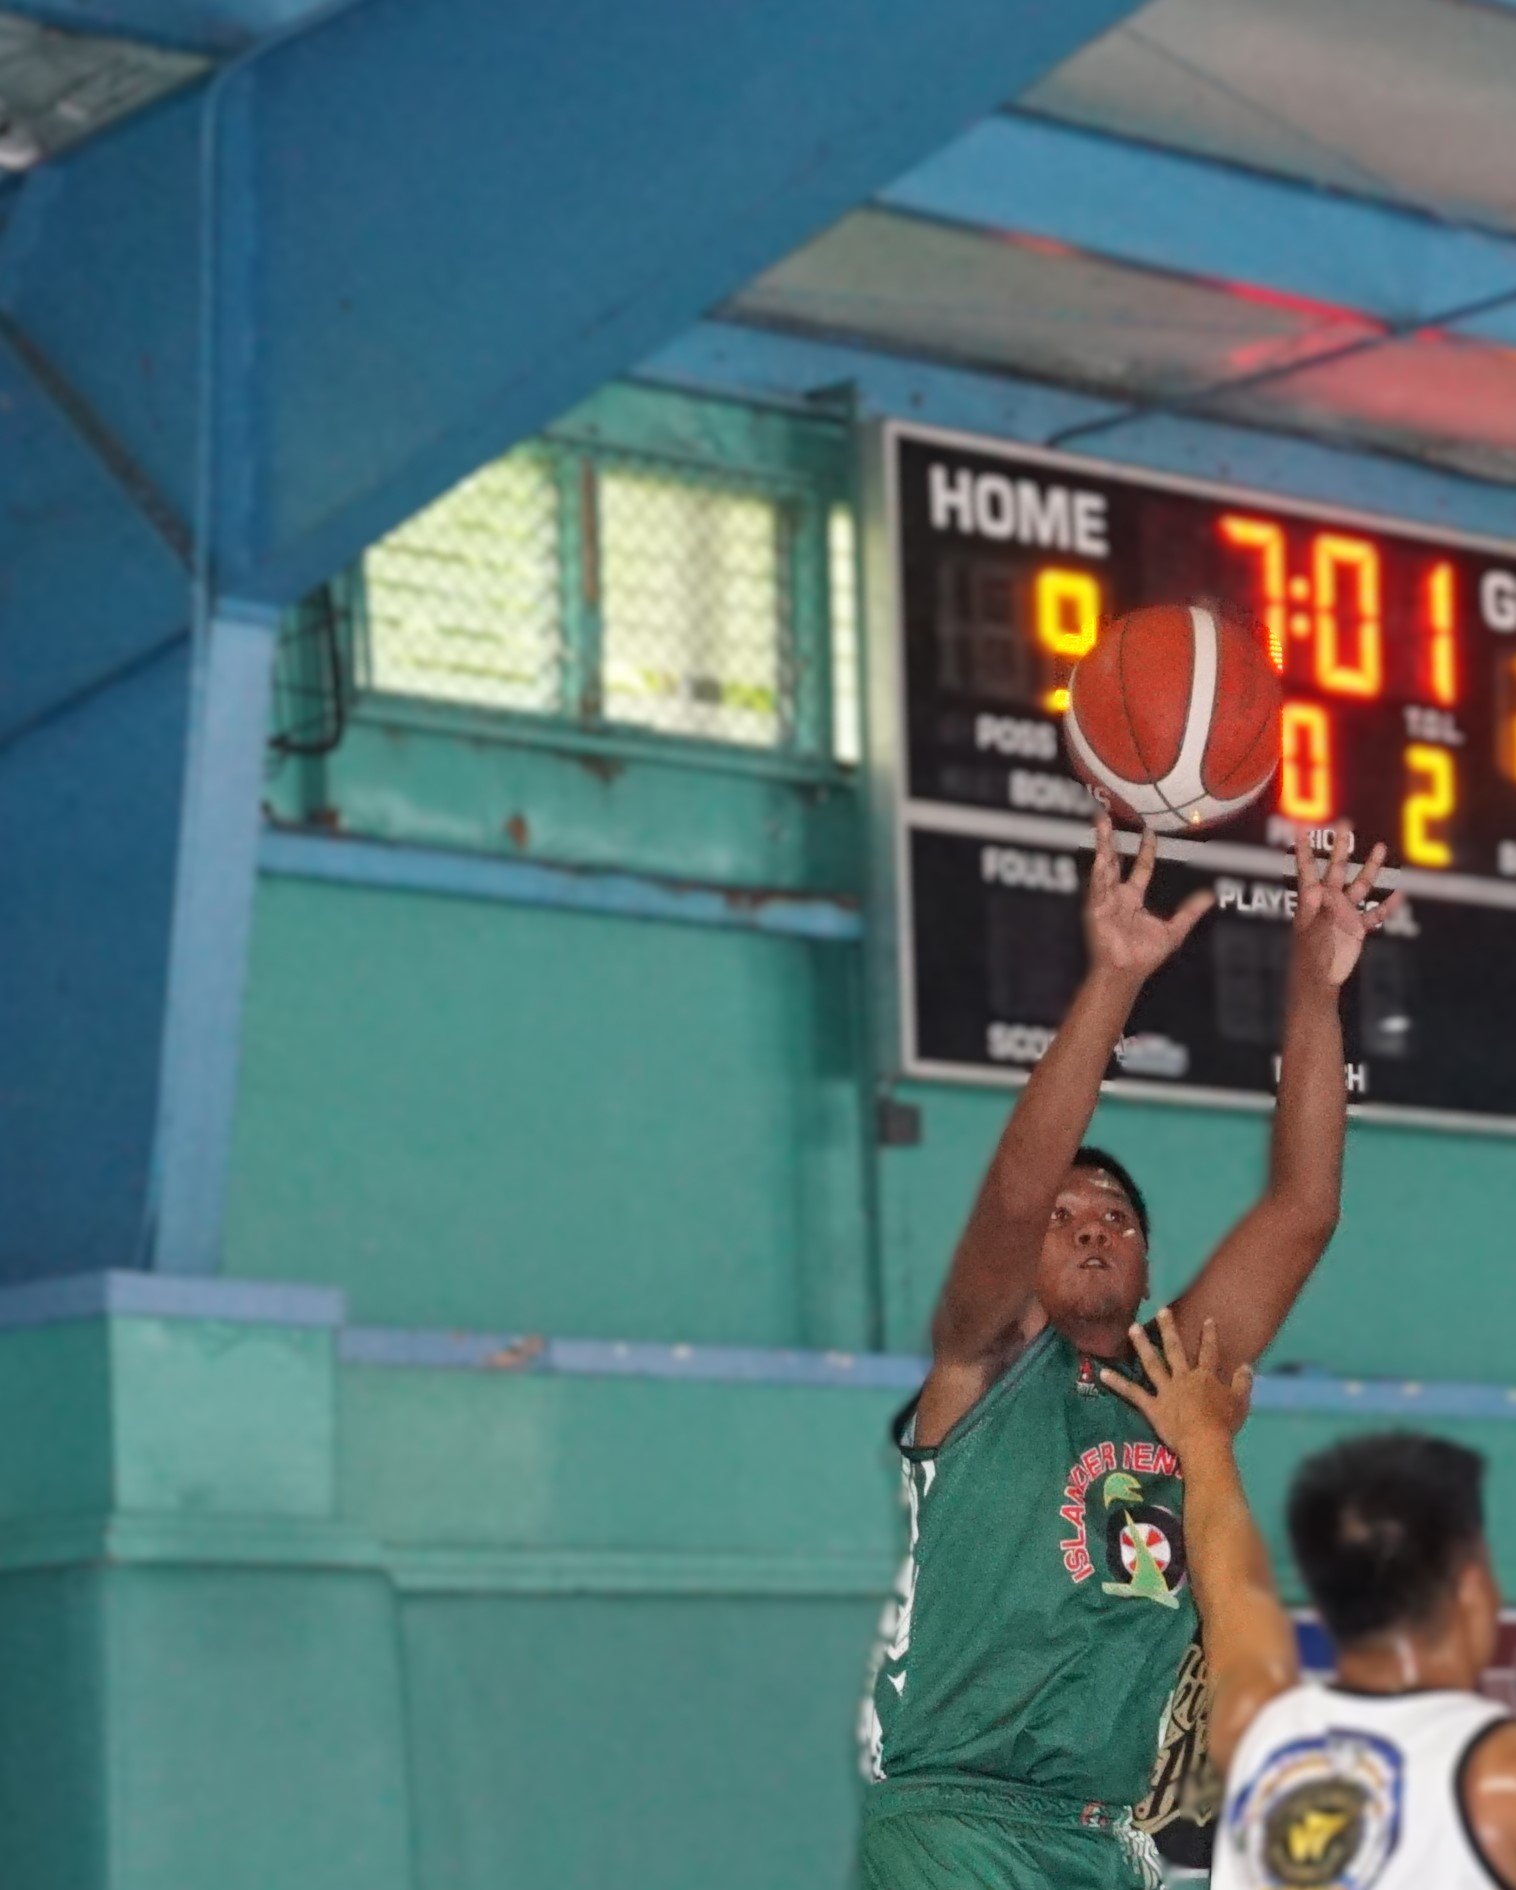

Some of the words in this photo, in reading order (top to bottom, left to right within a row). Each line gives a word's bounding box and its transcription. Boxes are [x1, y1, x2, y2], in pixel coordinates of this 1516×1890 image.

[928, 463, 1110, 557] HOME
[1216, 513, 1457, 706] 7:01
[1282, 703, 1332, 820] 0
[1402, 744, 1456, 868] 2
[981, 845, 1078, 893] FOULS
[1060, 1441, 1117, 1584] ISLANDER
